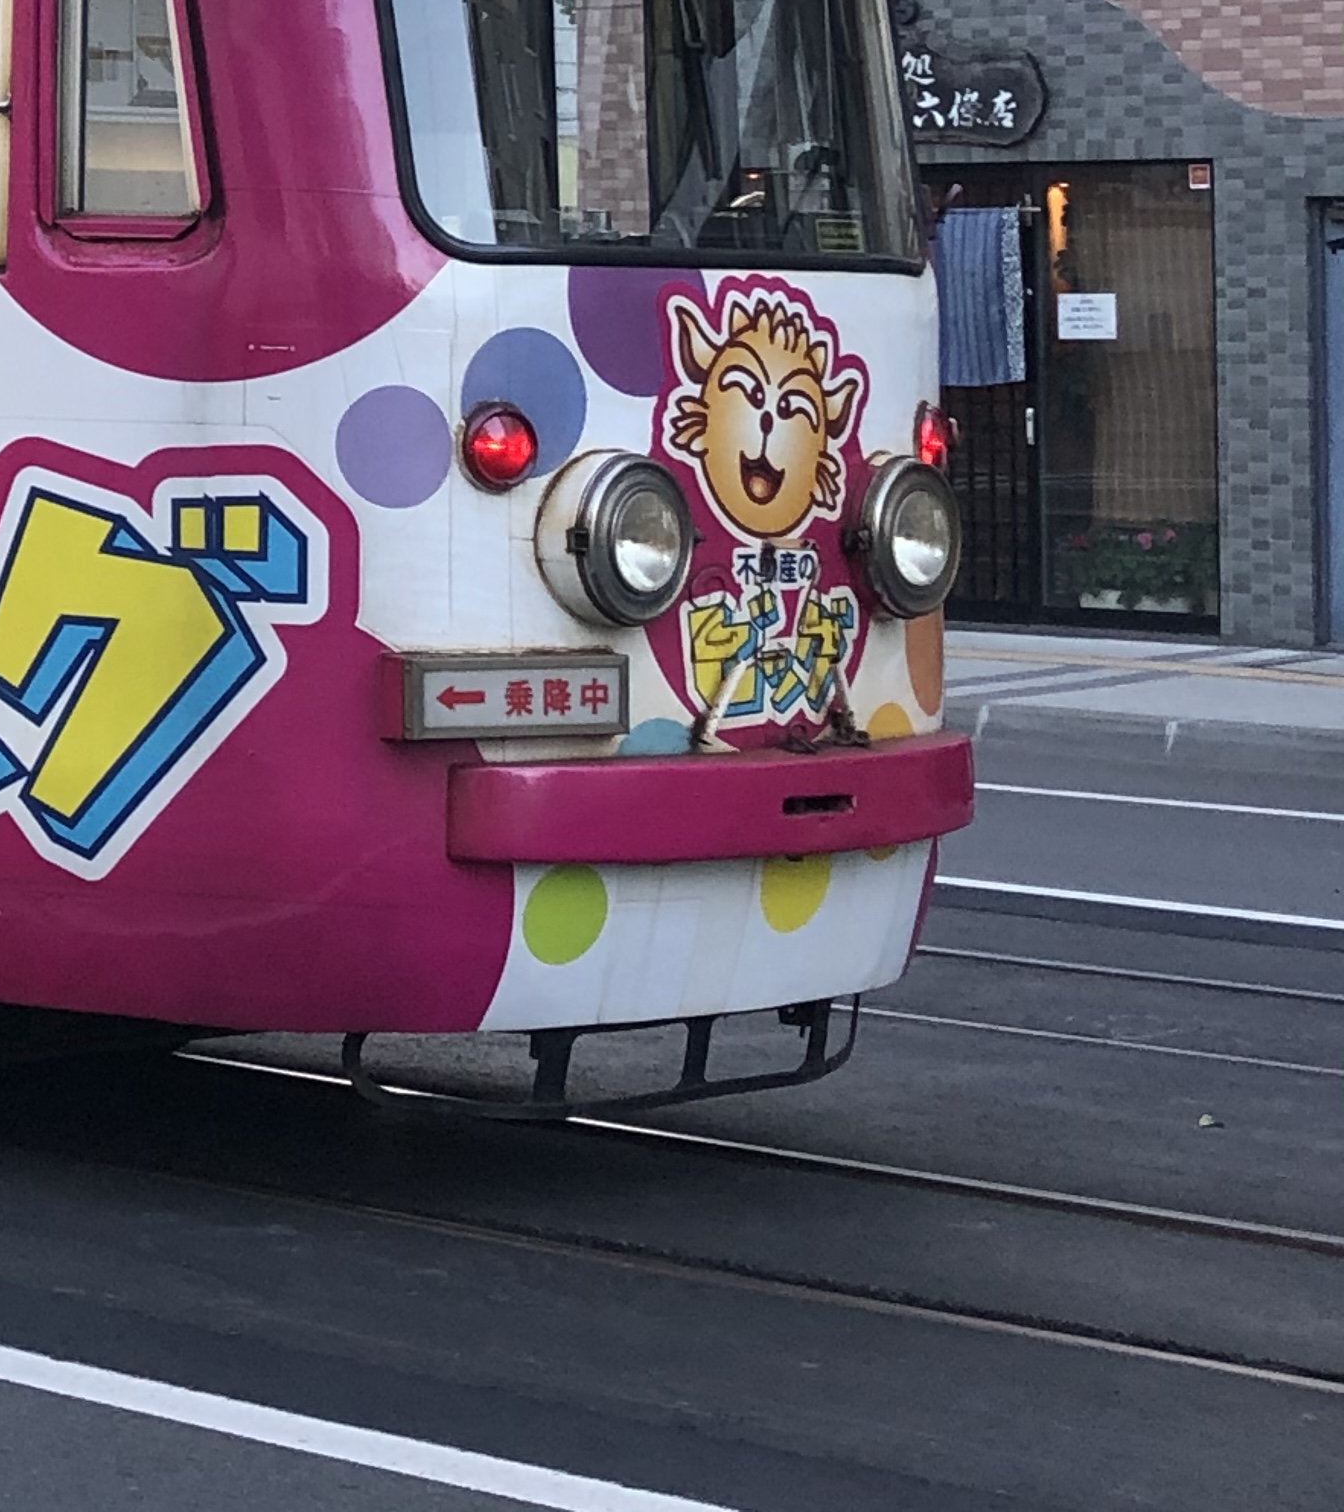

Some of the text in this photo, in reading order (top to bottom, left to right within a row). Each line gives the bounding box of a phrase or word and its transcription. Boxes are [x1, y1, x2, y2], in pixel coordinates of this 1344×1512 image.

[736, 552, 816, 585] 不産の
[504, 677, 609, 717] 乗降中
